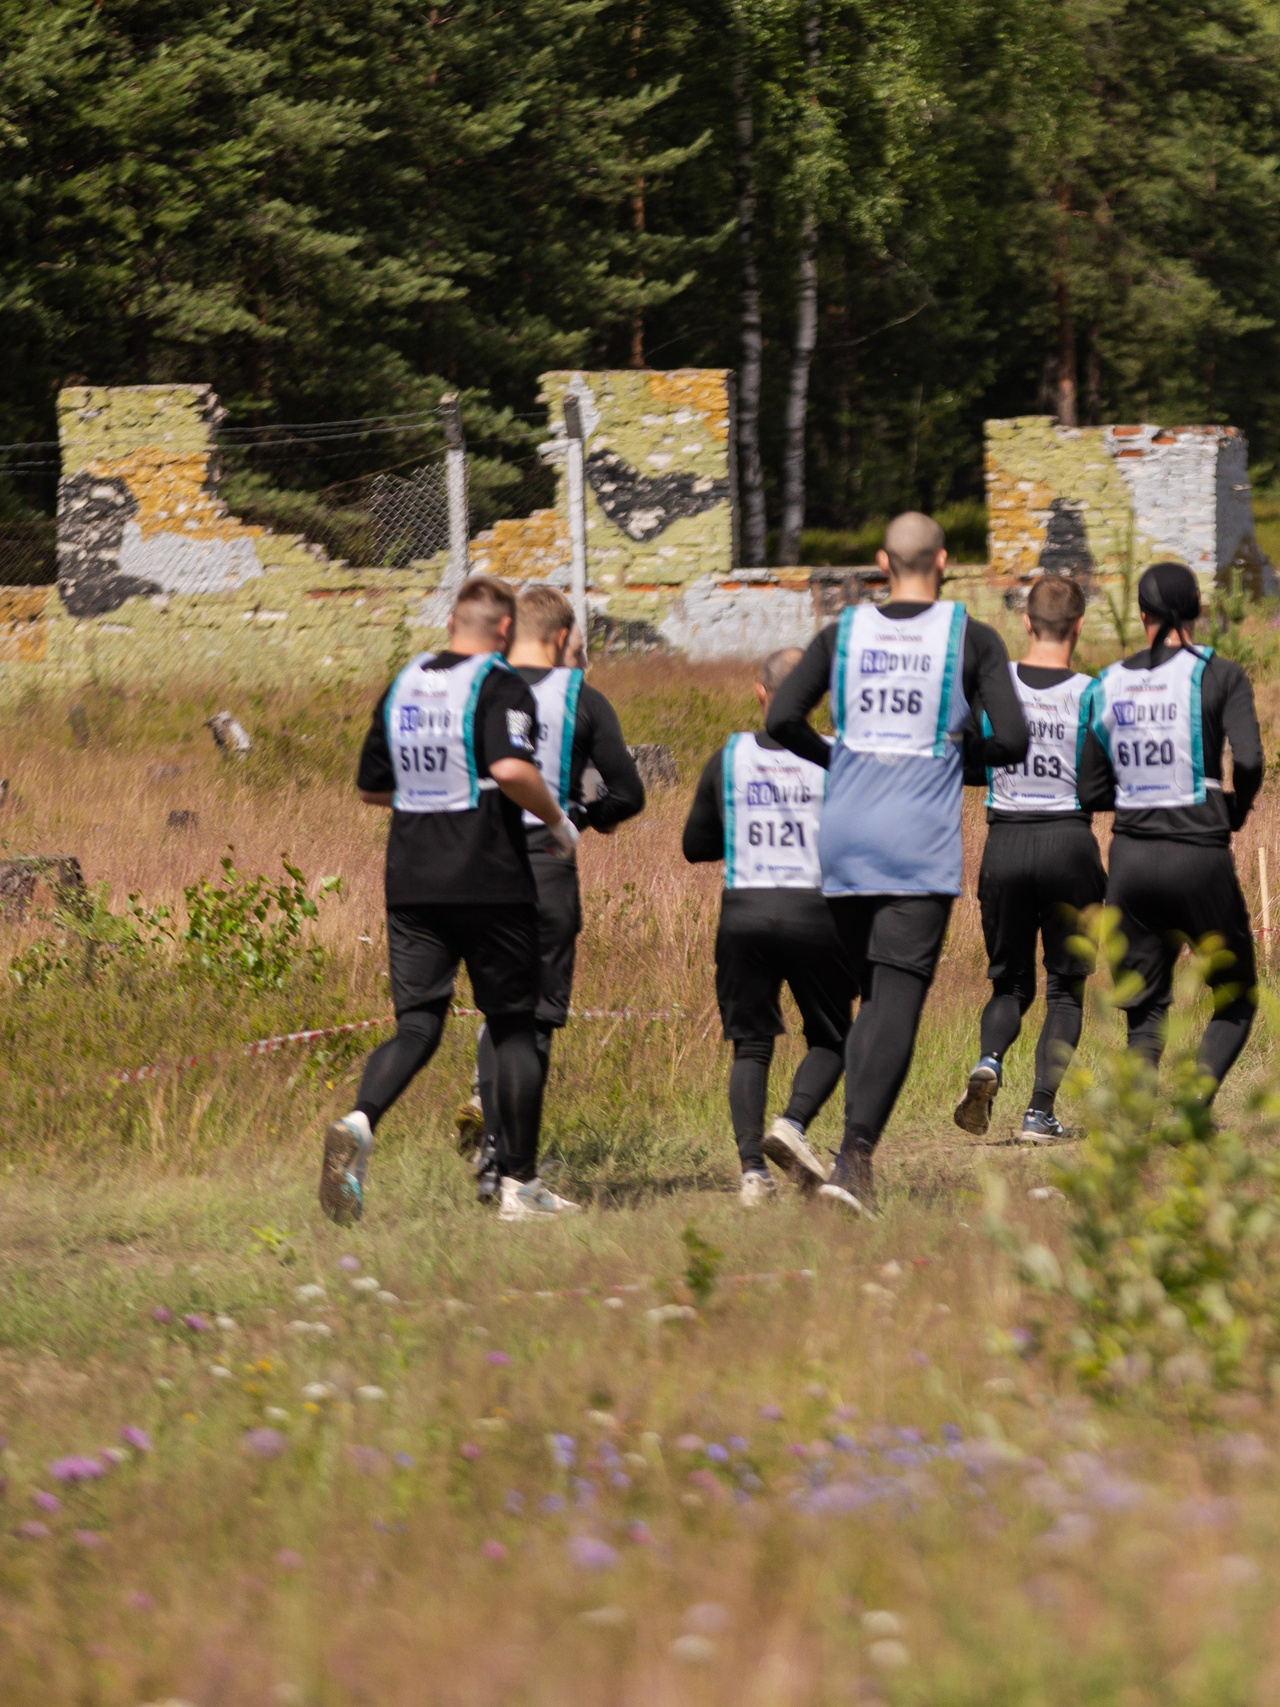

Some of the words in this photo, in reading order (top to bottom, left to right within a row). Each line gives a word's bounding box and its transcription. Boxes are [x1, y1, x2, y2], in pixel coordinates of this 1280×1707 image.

[861, 650, 932, 674] RODVIG
[860, 688, 923, 714] 5156
[1113, 701, 1177, 726] RODVIG
[401, 746, 448, 772] 5157
[1117, 739, 1174, 767] 6120
[748, 782, 811, 806] RODVIG
[749, 821, 806, 847] 6121
